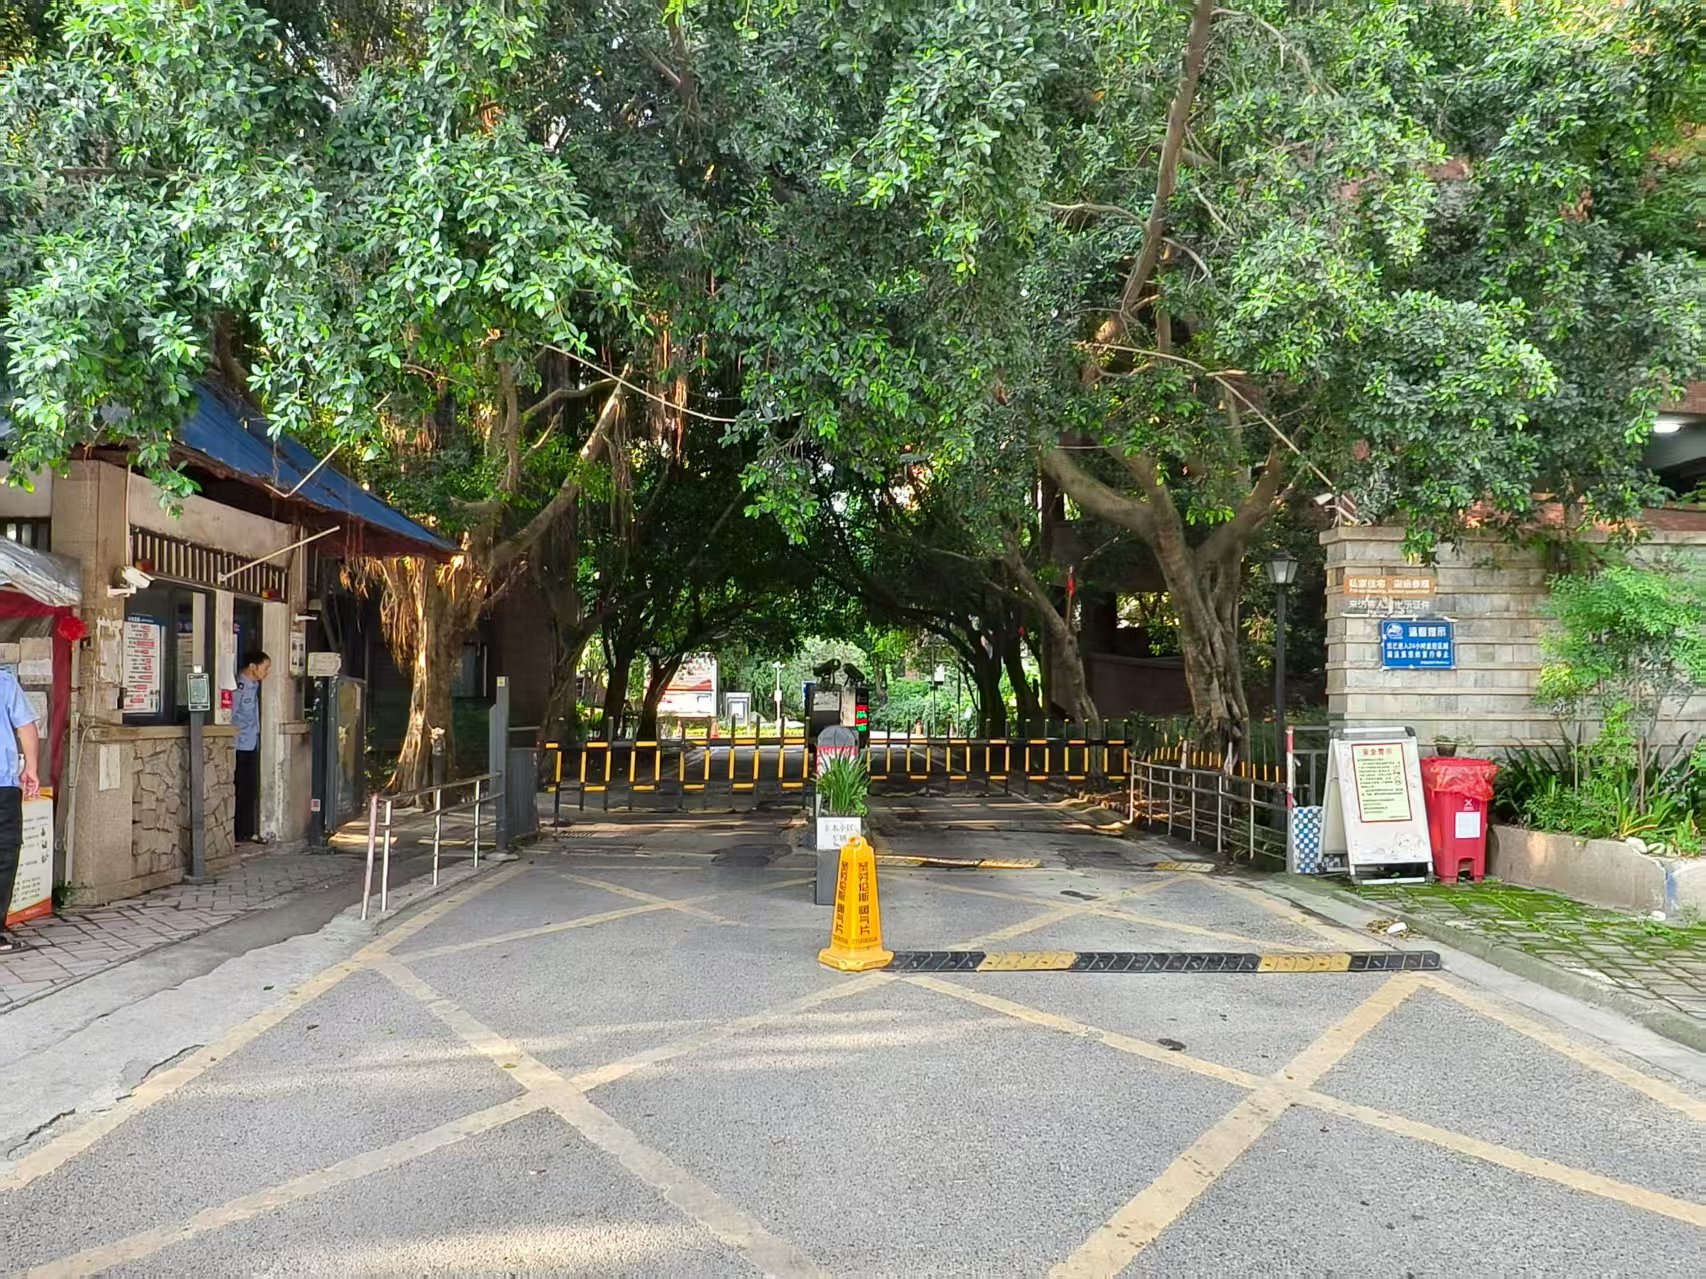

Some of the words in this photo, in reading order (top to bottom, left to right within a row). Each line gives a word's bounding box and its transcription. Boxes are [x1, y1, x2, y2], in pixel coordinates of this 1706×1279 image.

[1348, 600, 1430, 609] 来访客人出示证件
